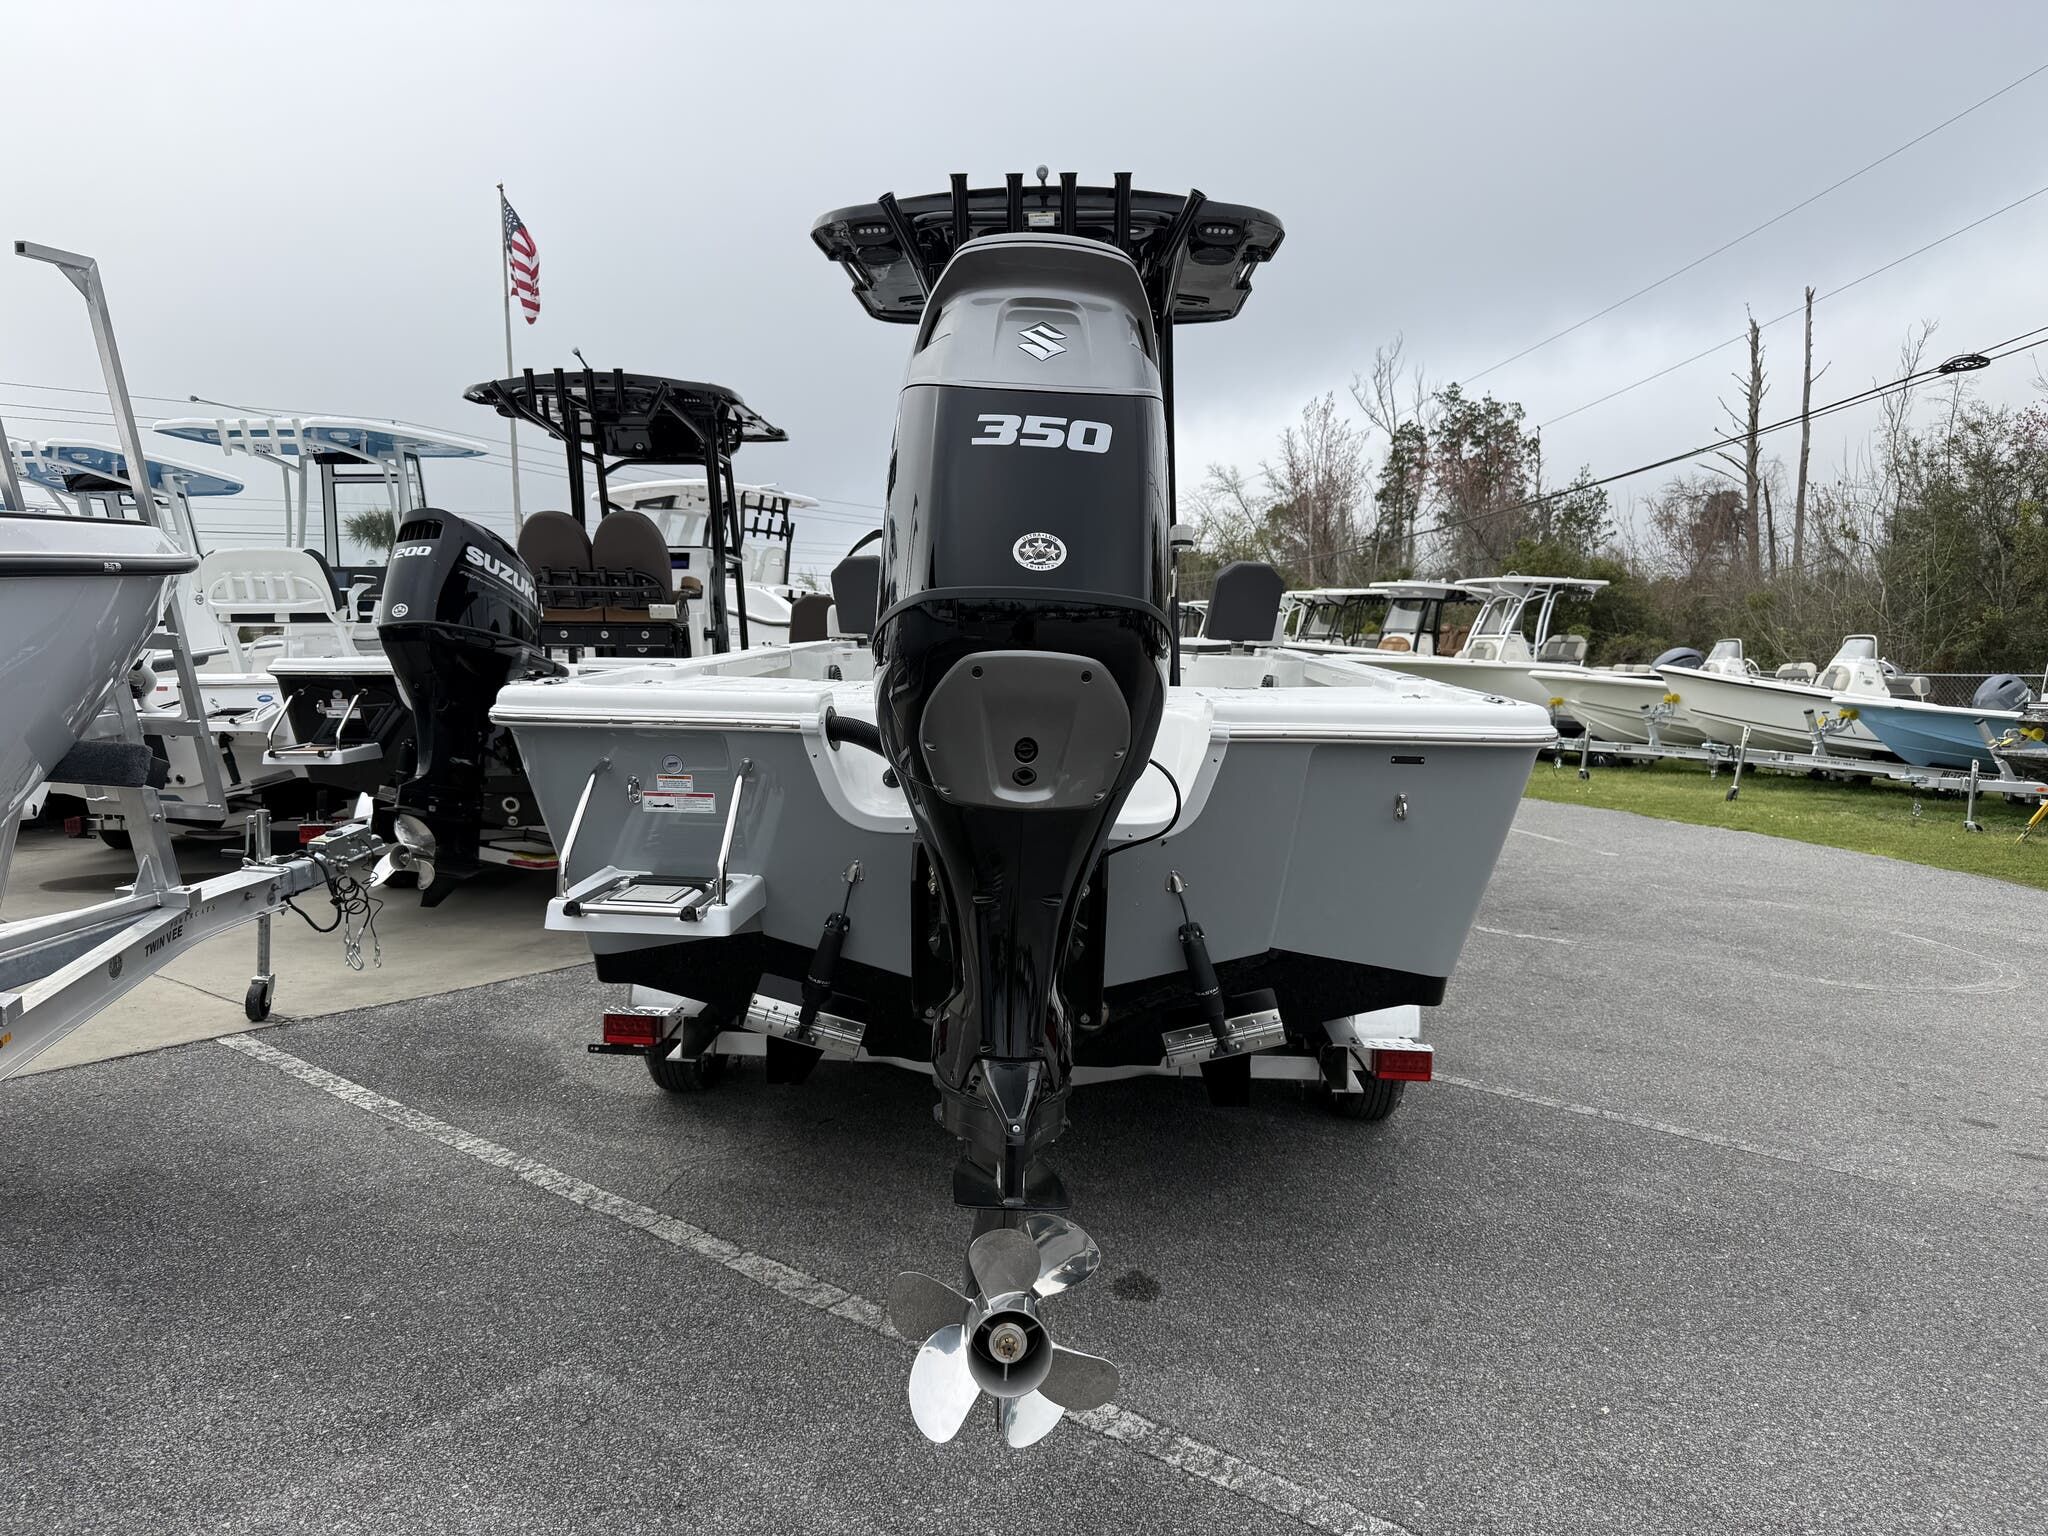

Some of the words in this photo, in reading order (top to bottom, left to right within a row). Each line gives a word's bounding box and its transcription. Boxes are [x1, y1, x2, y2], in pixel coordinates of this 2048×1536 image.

[971, 414, 1113, 454] 350
[394, 545, 432, 559] 200
[145, 937, 165, 957] TWIN
[166, 925, 183, 943] VEE
